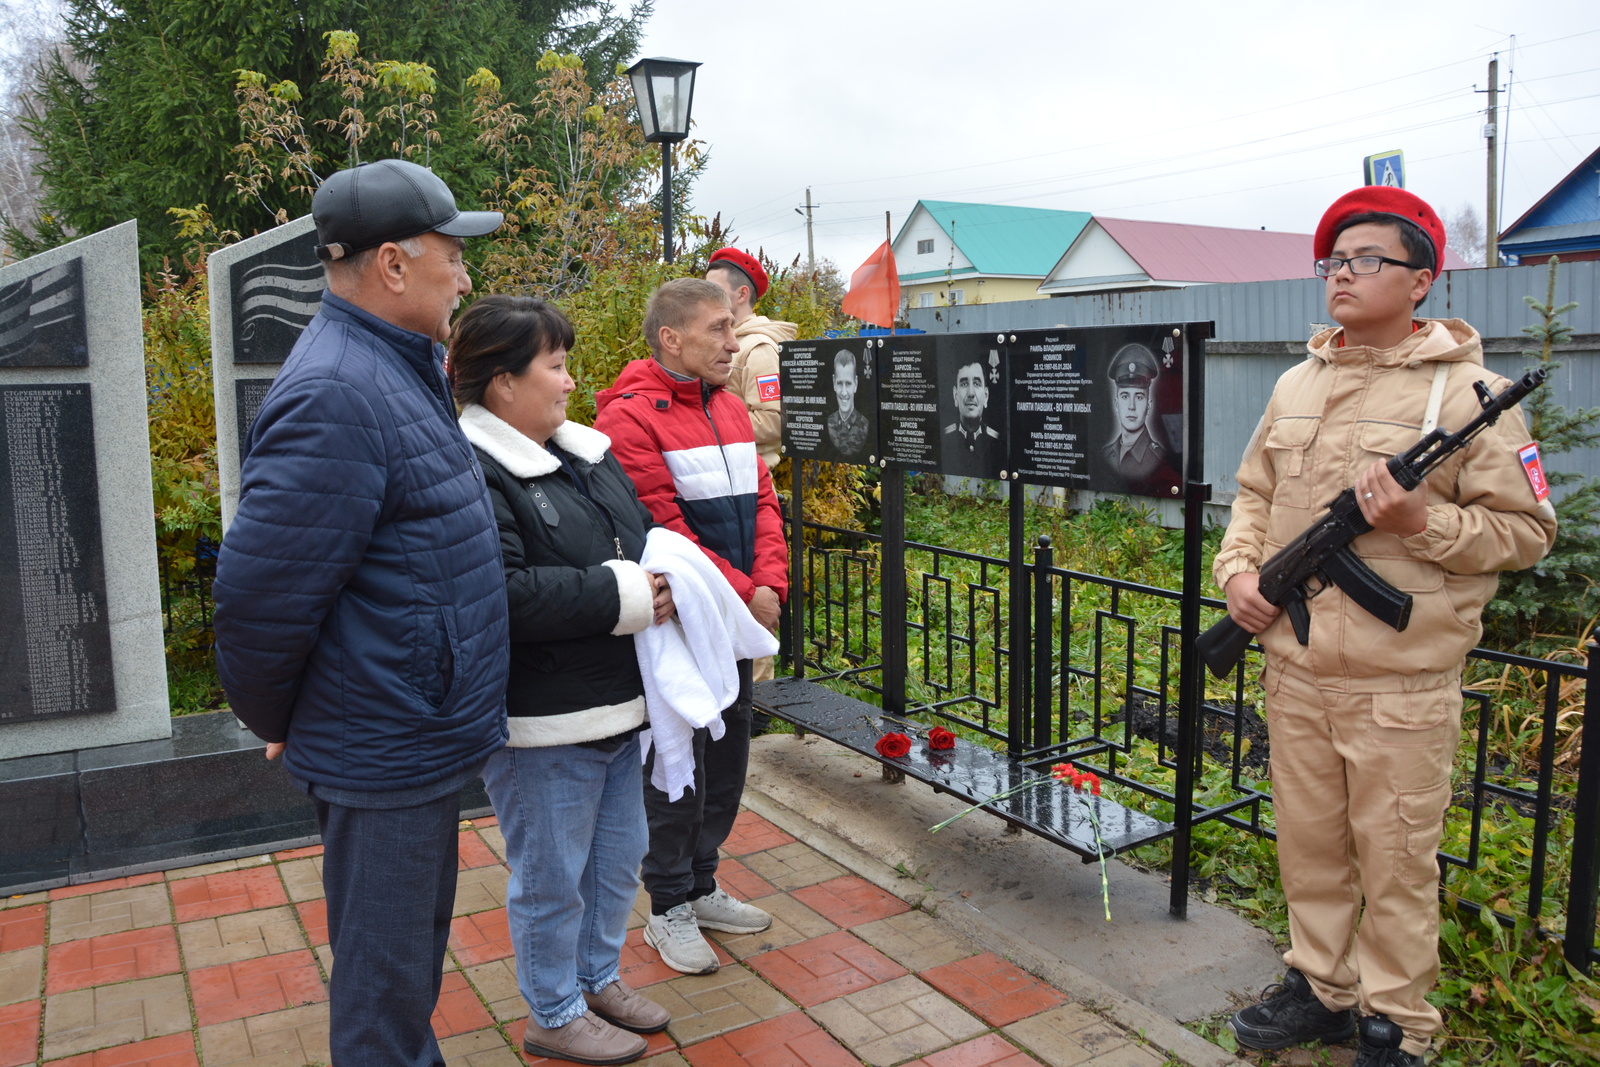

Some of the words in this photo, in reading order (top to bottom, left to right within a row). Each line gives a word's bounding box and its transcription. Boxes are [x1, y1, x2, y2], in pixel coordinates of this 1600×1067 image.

[1043, 344, 1076, 352] ВЛАДИМИРОВИЧ
[1017, 402, 1034, 411] ПАМЯТИ
[1035, 402, 1053, 412] ПАВШИХ
[1056, 403, 1063, 412] ВО
[1063, 403, 1073, 412] ИМЯ
[1074, 403, 1092, 412] ЖИВЫХ
[1044, 433, 1076, 441] ВЛАДИМИРОВИЧ
